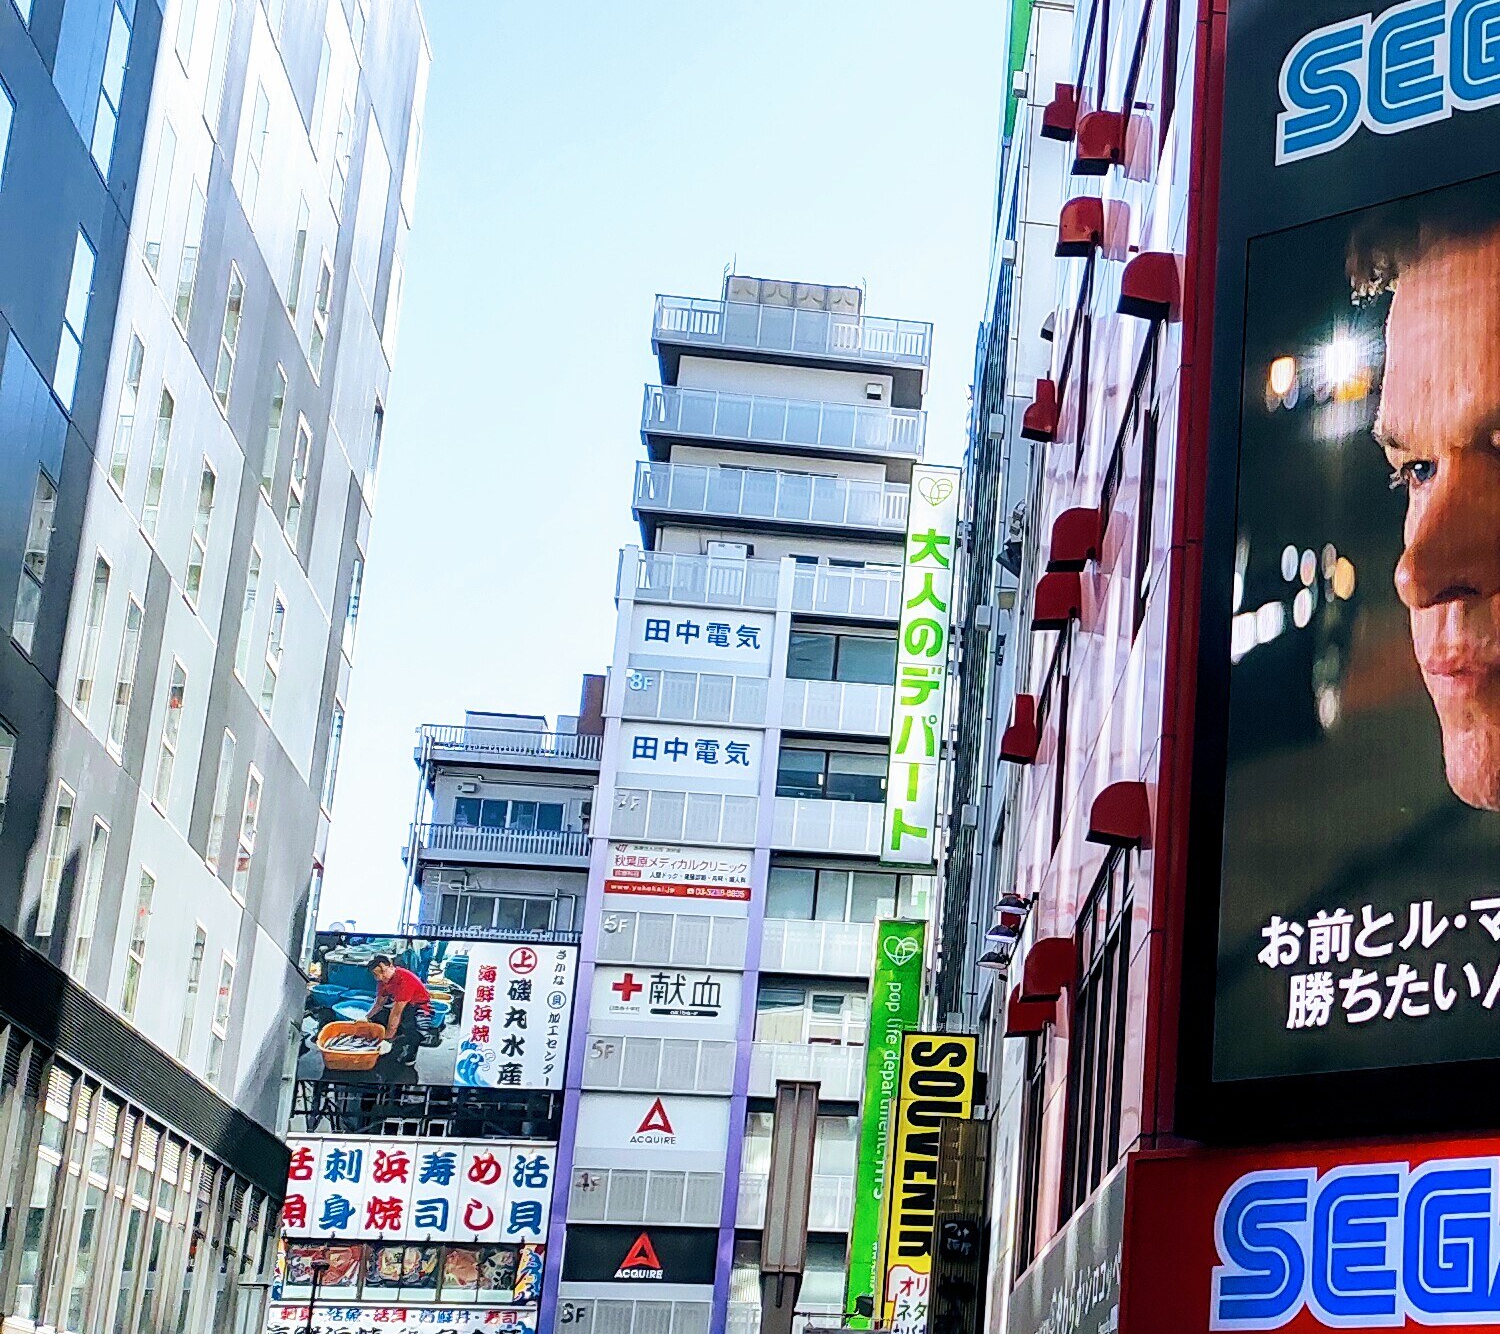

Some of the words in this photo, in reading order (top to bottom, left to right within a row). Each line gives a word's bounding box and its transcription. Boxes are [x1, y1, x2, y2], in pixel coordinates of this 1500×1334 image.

[644, 618, 761, 650] 田中電気
[629, 672, 654, 692] 8F
[890, 528, 951, 854] 大人のデパート
[632, 736, 751, 766] 田中電気
[471, 964, 497, 1044] 海鮮浜焼
[649, 972, 722, 1009] 献血
[886, 981, 902, 1012] pop
[497, 979, 532, 1085] 磯丸水産
[590, 1039, 614, 1060] 5F
[630, 1136, 676, 1145] ACQUIRE
[898, 1041, 967, 1257] SOUVENIR
[319, 1148, 363, 1231] 刺身
[365, 1150, 411, 1231] 浜焼
[415, 1152, 457, 1231] 寿司
[463, 1154, 502, 1231] めし
[507, 1154, 550, 1235] 活貝
[614, 1269, 663, 1279] ACQUIRE
